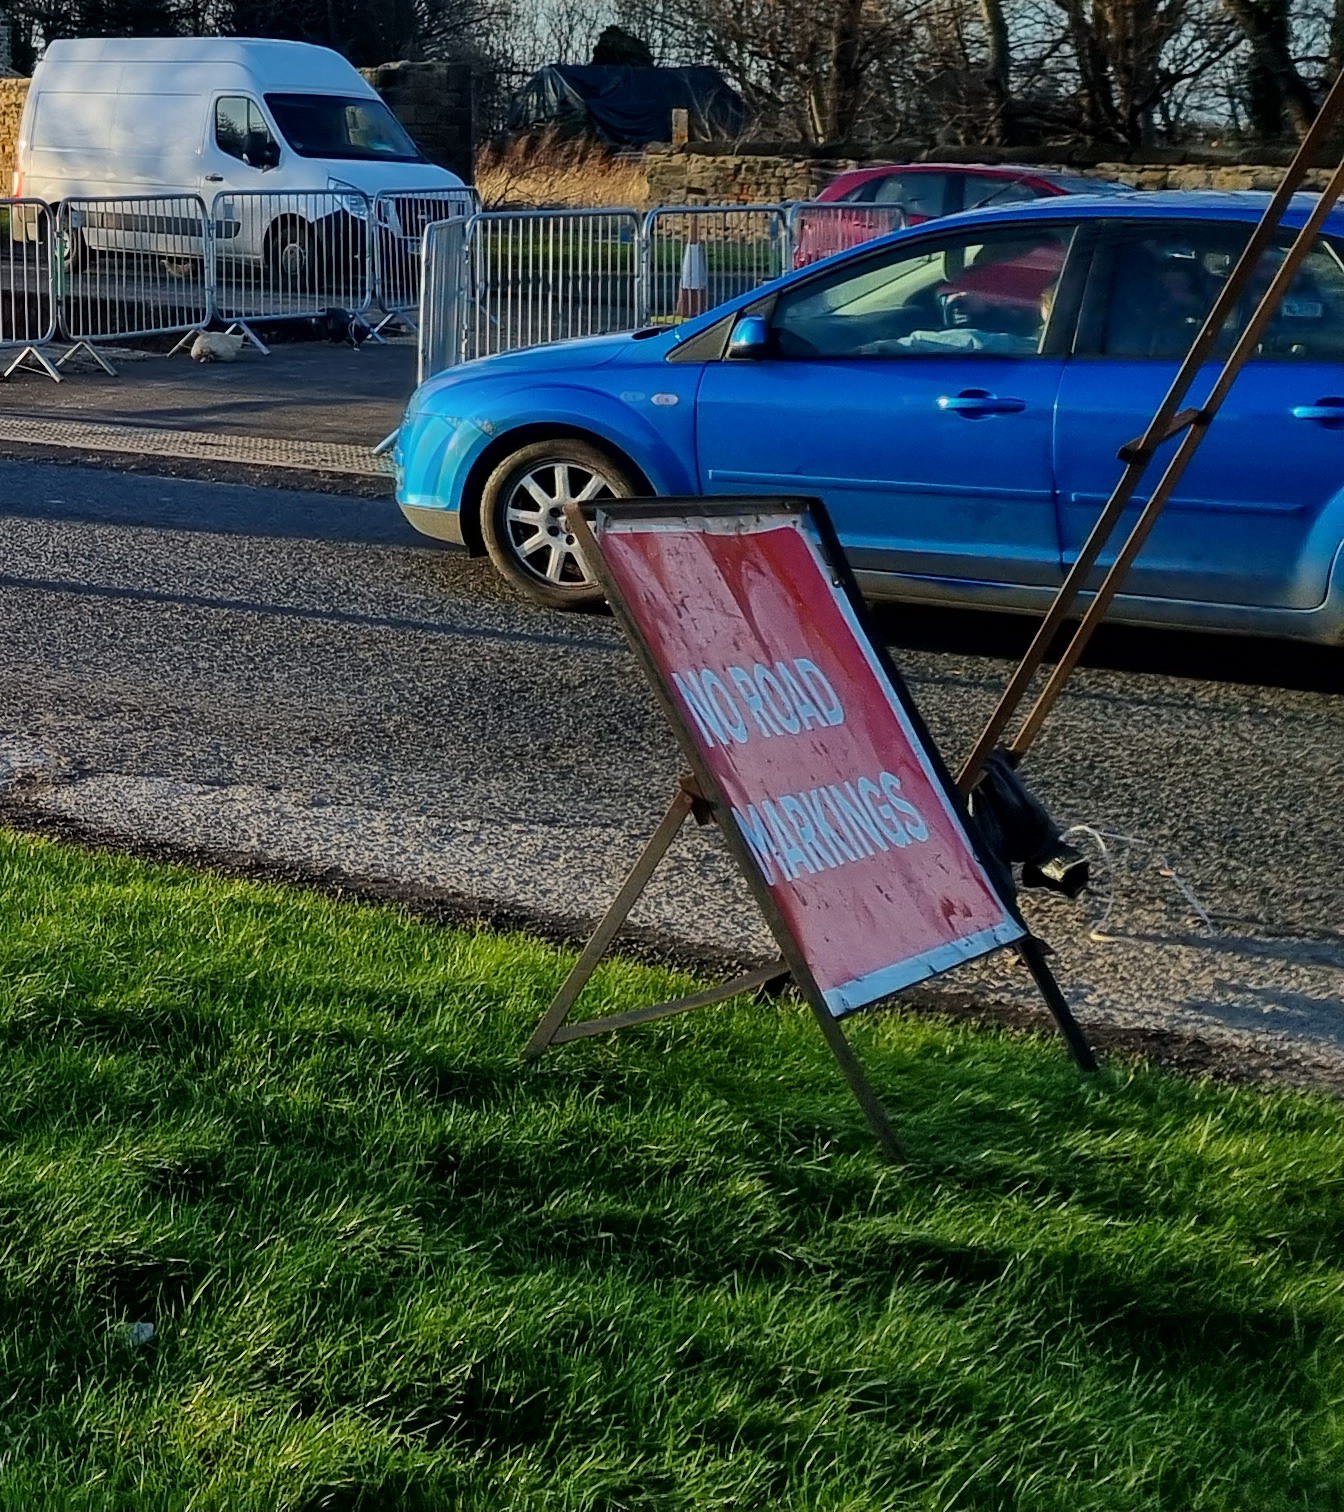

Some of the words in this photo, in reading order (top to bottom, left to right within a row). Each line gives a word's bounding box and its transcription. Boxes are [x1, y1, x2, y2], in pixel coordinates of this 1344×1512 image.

[672, 668, 748, 747] NO
[727, 658, 844, 737] ROAD
[731, 771, 929, 886] MARKINGS
